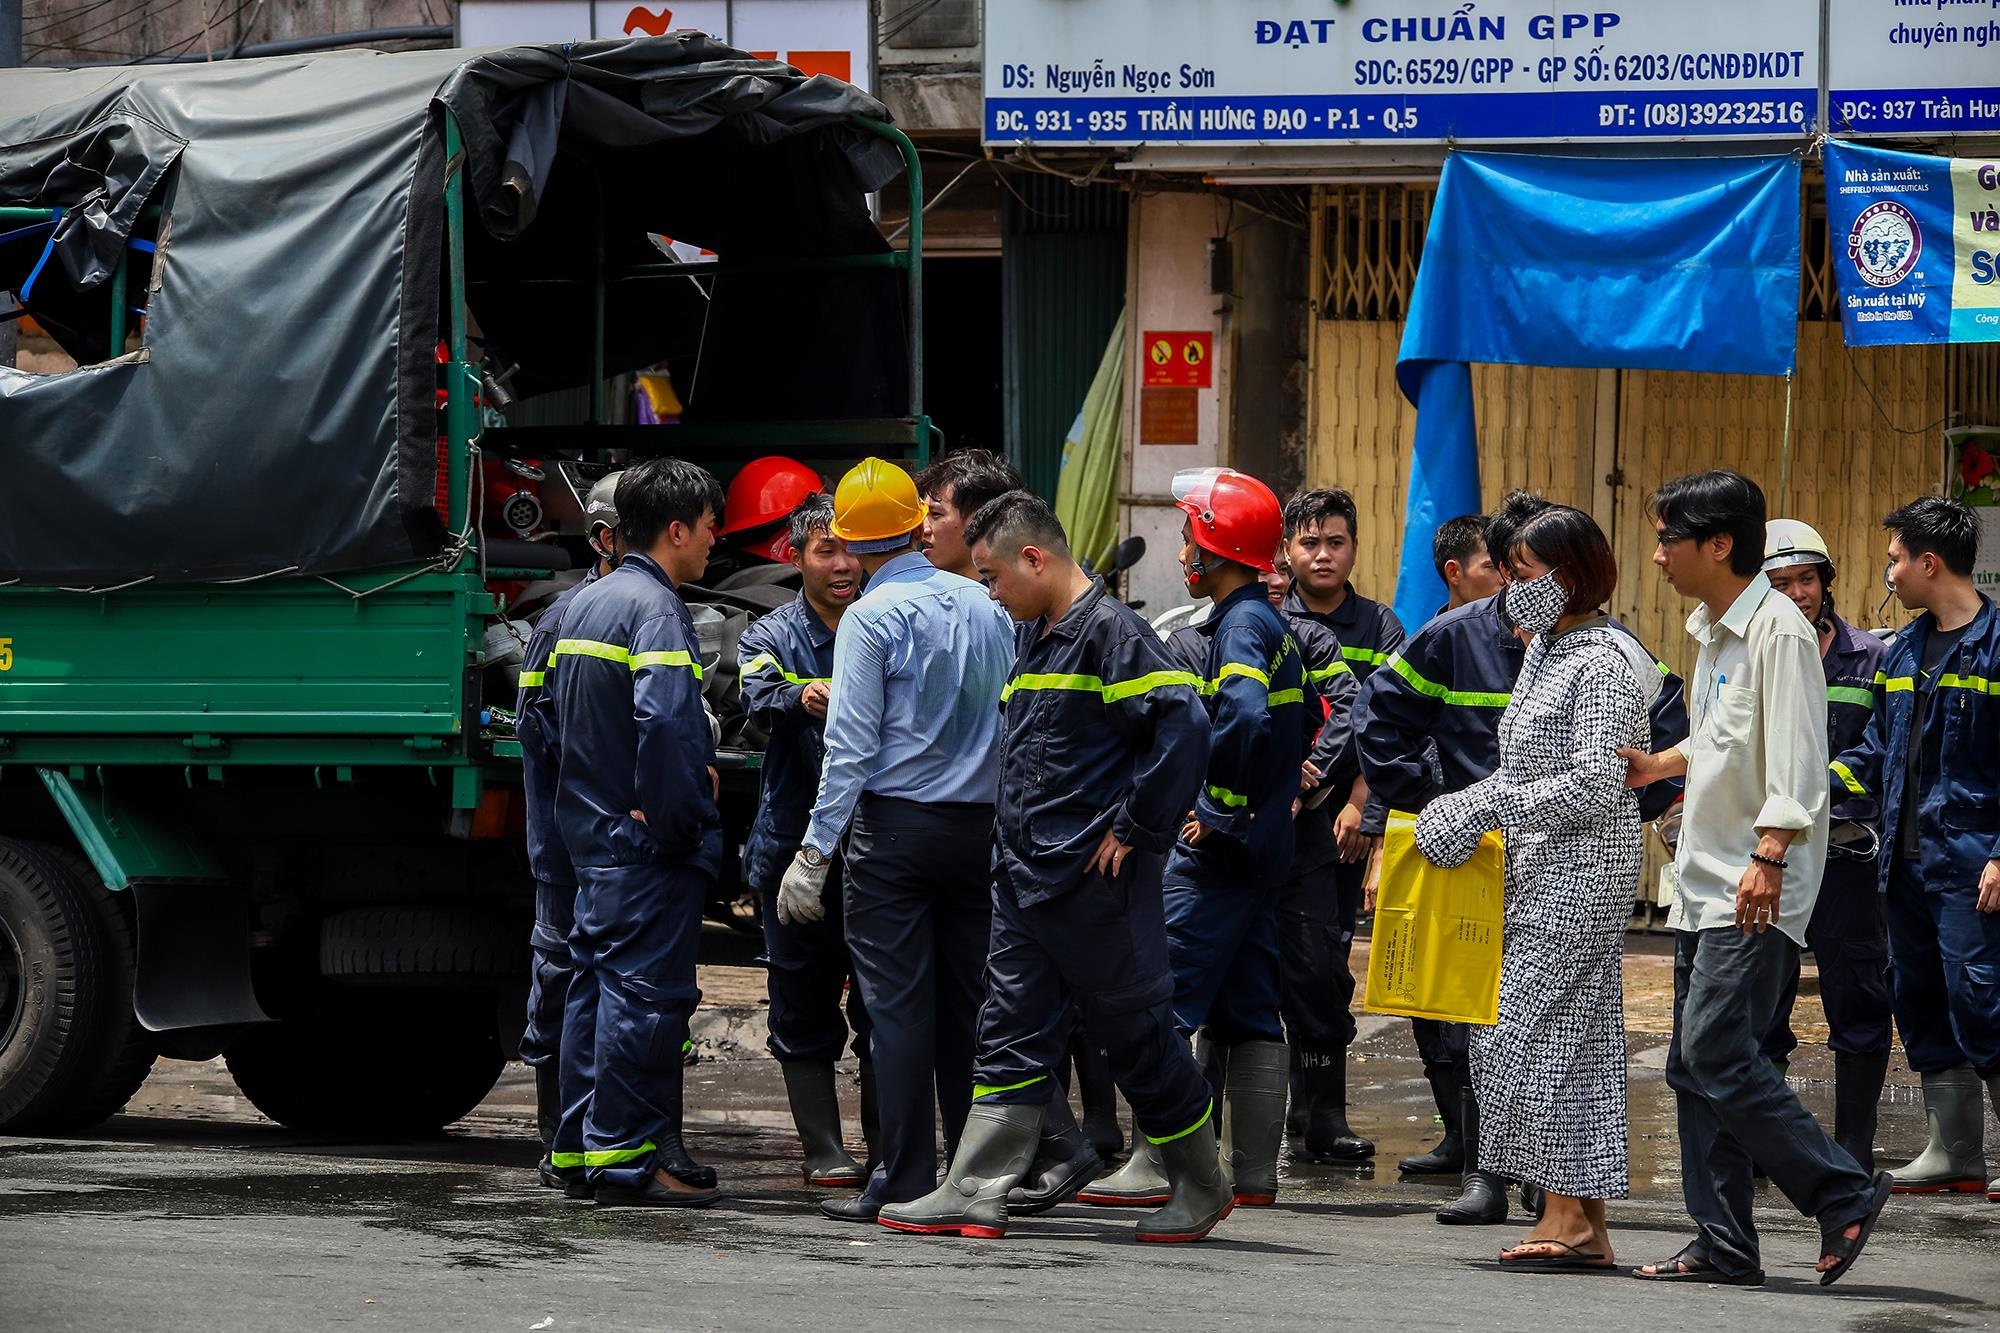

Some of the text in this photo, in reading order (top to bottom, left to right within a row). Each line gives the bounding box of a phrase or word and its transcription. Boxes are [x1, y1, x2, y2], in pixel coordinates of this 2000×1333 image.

[1255, 3, 1620, 49] ĐẠT CHUẨN GPP
[1889, 22, 1957, 48] chuyên
[1003, 59, 1214, 93] DS: Nguyễn Ngọc Sơn
[1538, 57, 1566, 83] GP
[1036, 111, 1071, 130] 931
[1089, 111, 1126, 131] 935
[1138, 102, 1192, 130] TRẦN
[1200, 106, 1255, 130] HƯNG
[1263, 109, 1306, 134] ĐẠO
[1599, 105, 1634, 125] ĐT:
[1842, 96, 2000, 120] ĐC: 937 Trần Hư
[1845, 166, 1921, 182] Nhà sản xuất:
[1840, 184, 1929, 194] SHEFFIELD PHARMACEUTICALS
[1970, 250, 2000, 285] S
[1848, 292, 1926, 309] Sản xuất tại Mỹ
[1857, 311, 1914, 321] Made in the USA
